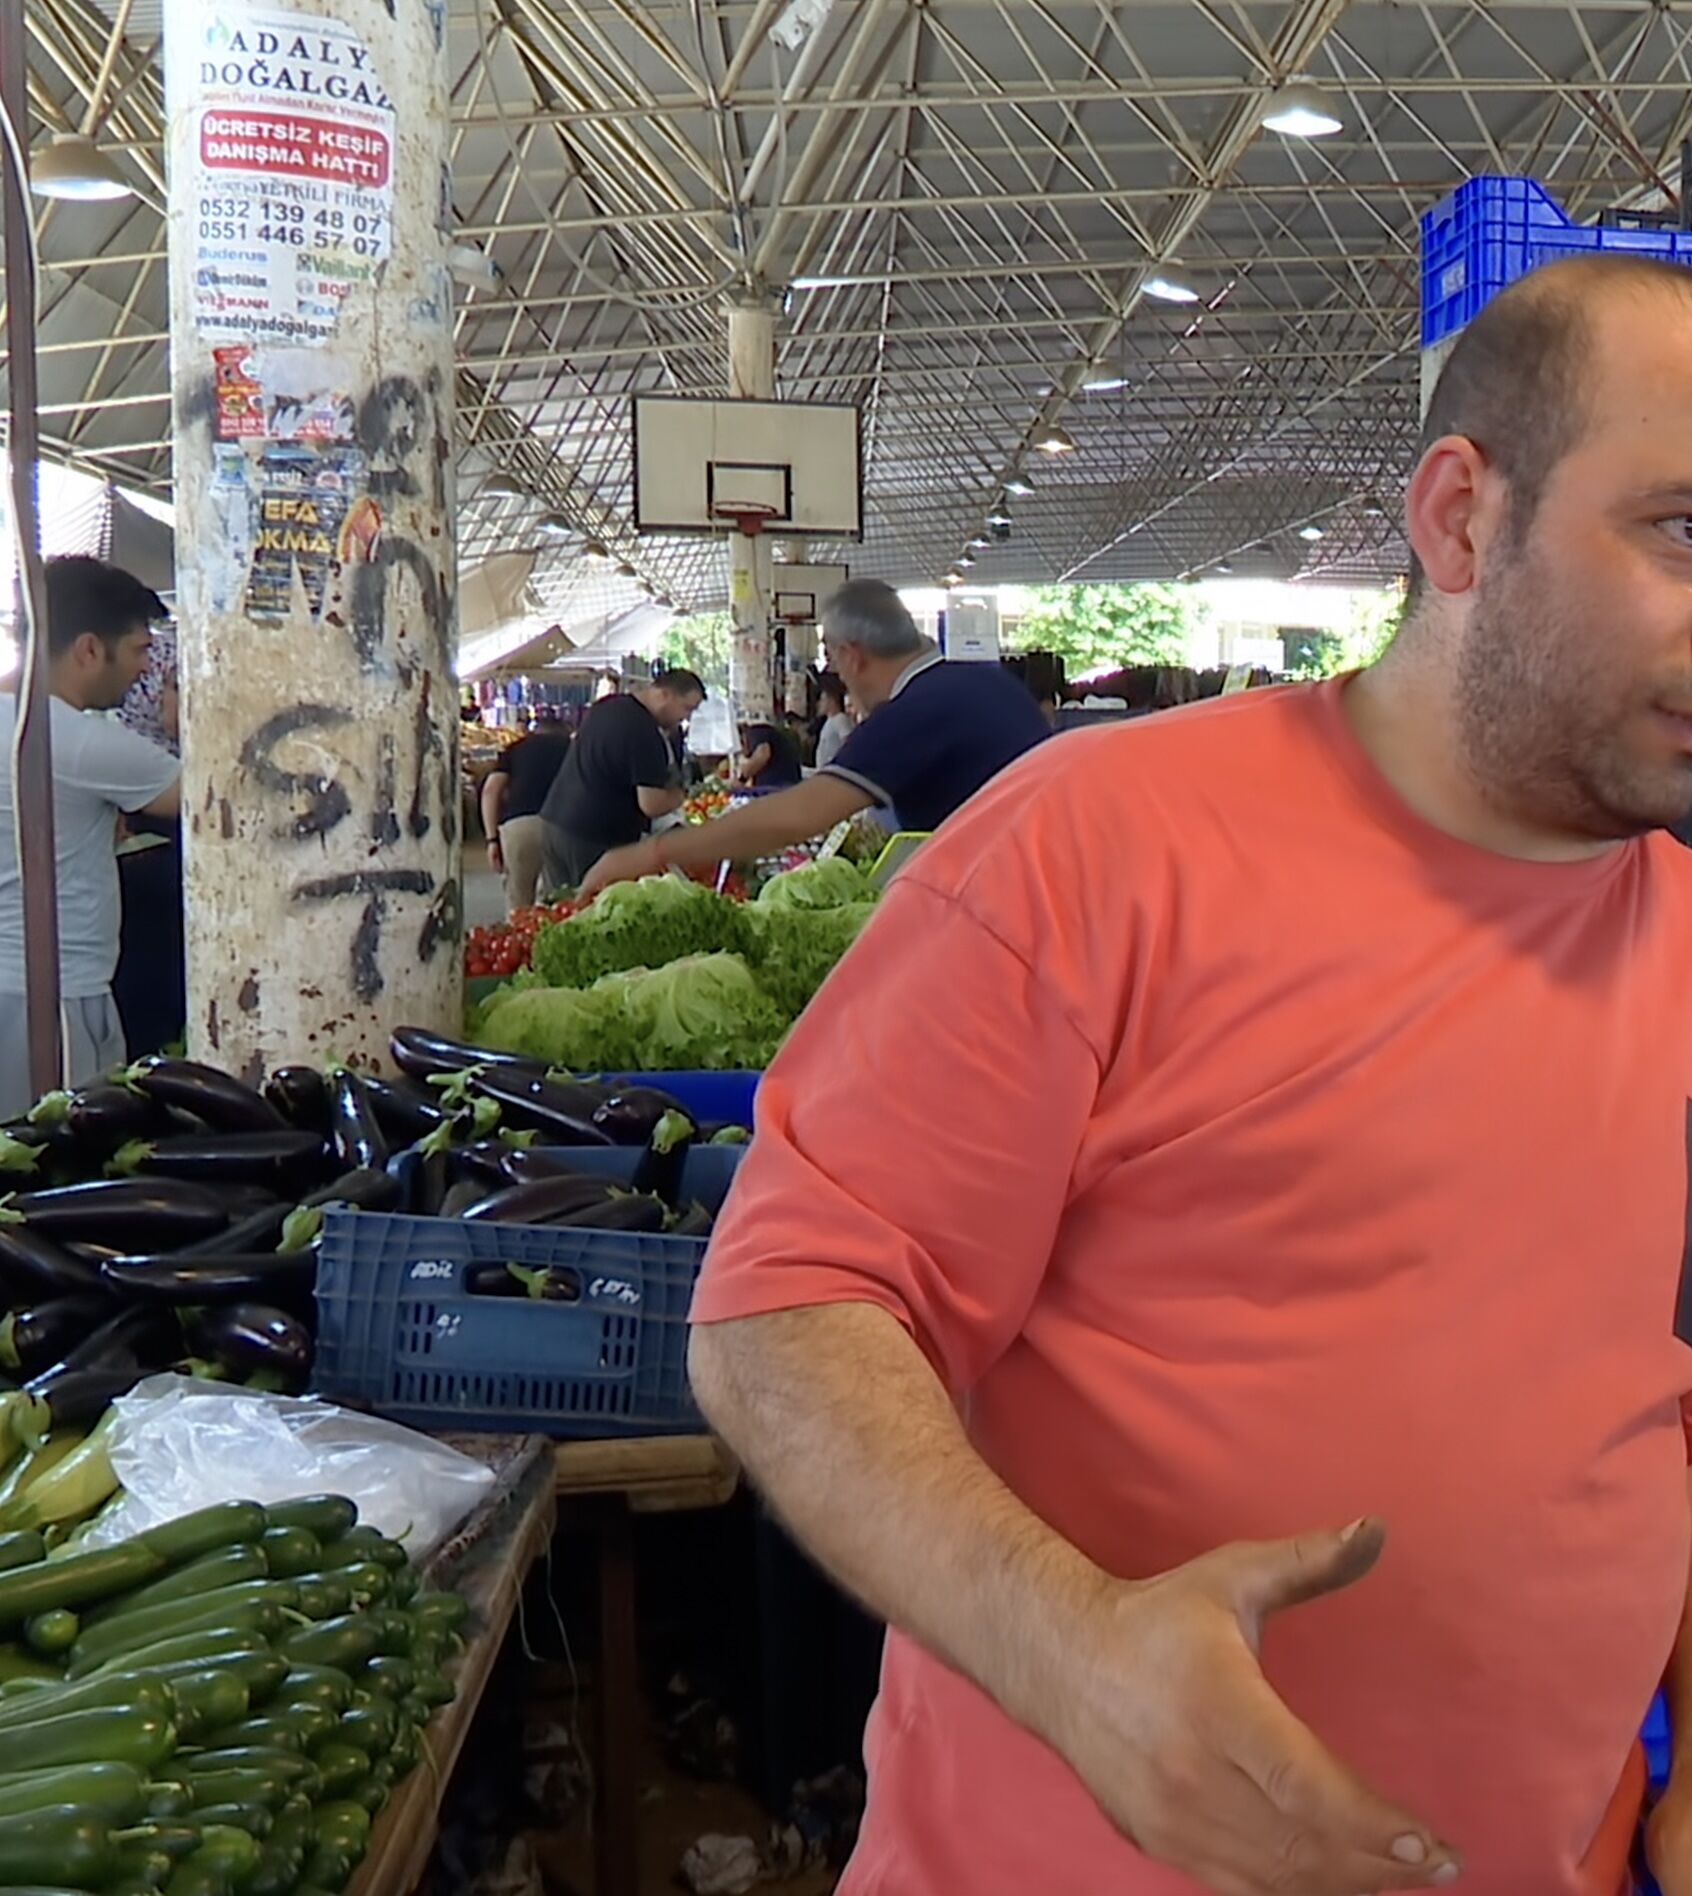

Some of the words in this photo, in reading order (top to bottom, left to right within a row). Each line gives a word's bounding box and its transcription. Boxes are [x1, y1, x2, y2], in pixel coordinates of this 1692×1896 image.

[229, 30, 377, 74] ADALY
[203, 115, 312, 143] ÜCRETSİZ
[318, 130, 385, 156] KEŞİF
[206, 141, 305, 166] DANIŞMA
[311, 152, 379, 179] HATTI
[200, 198, 250, 219] 0532
[260, 201, 305, 224] 139
[313, 209, 345, 230] 48
[353, 214, 382, 235] 07
[199, 220, 247, 241] 0551
[257, 224, 305, 246] 446
[314, 231, 345, 251] 57
[353, 236, 381, 257] 07
